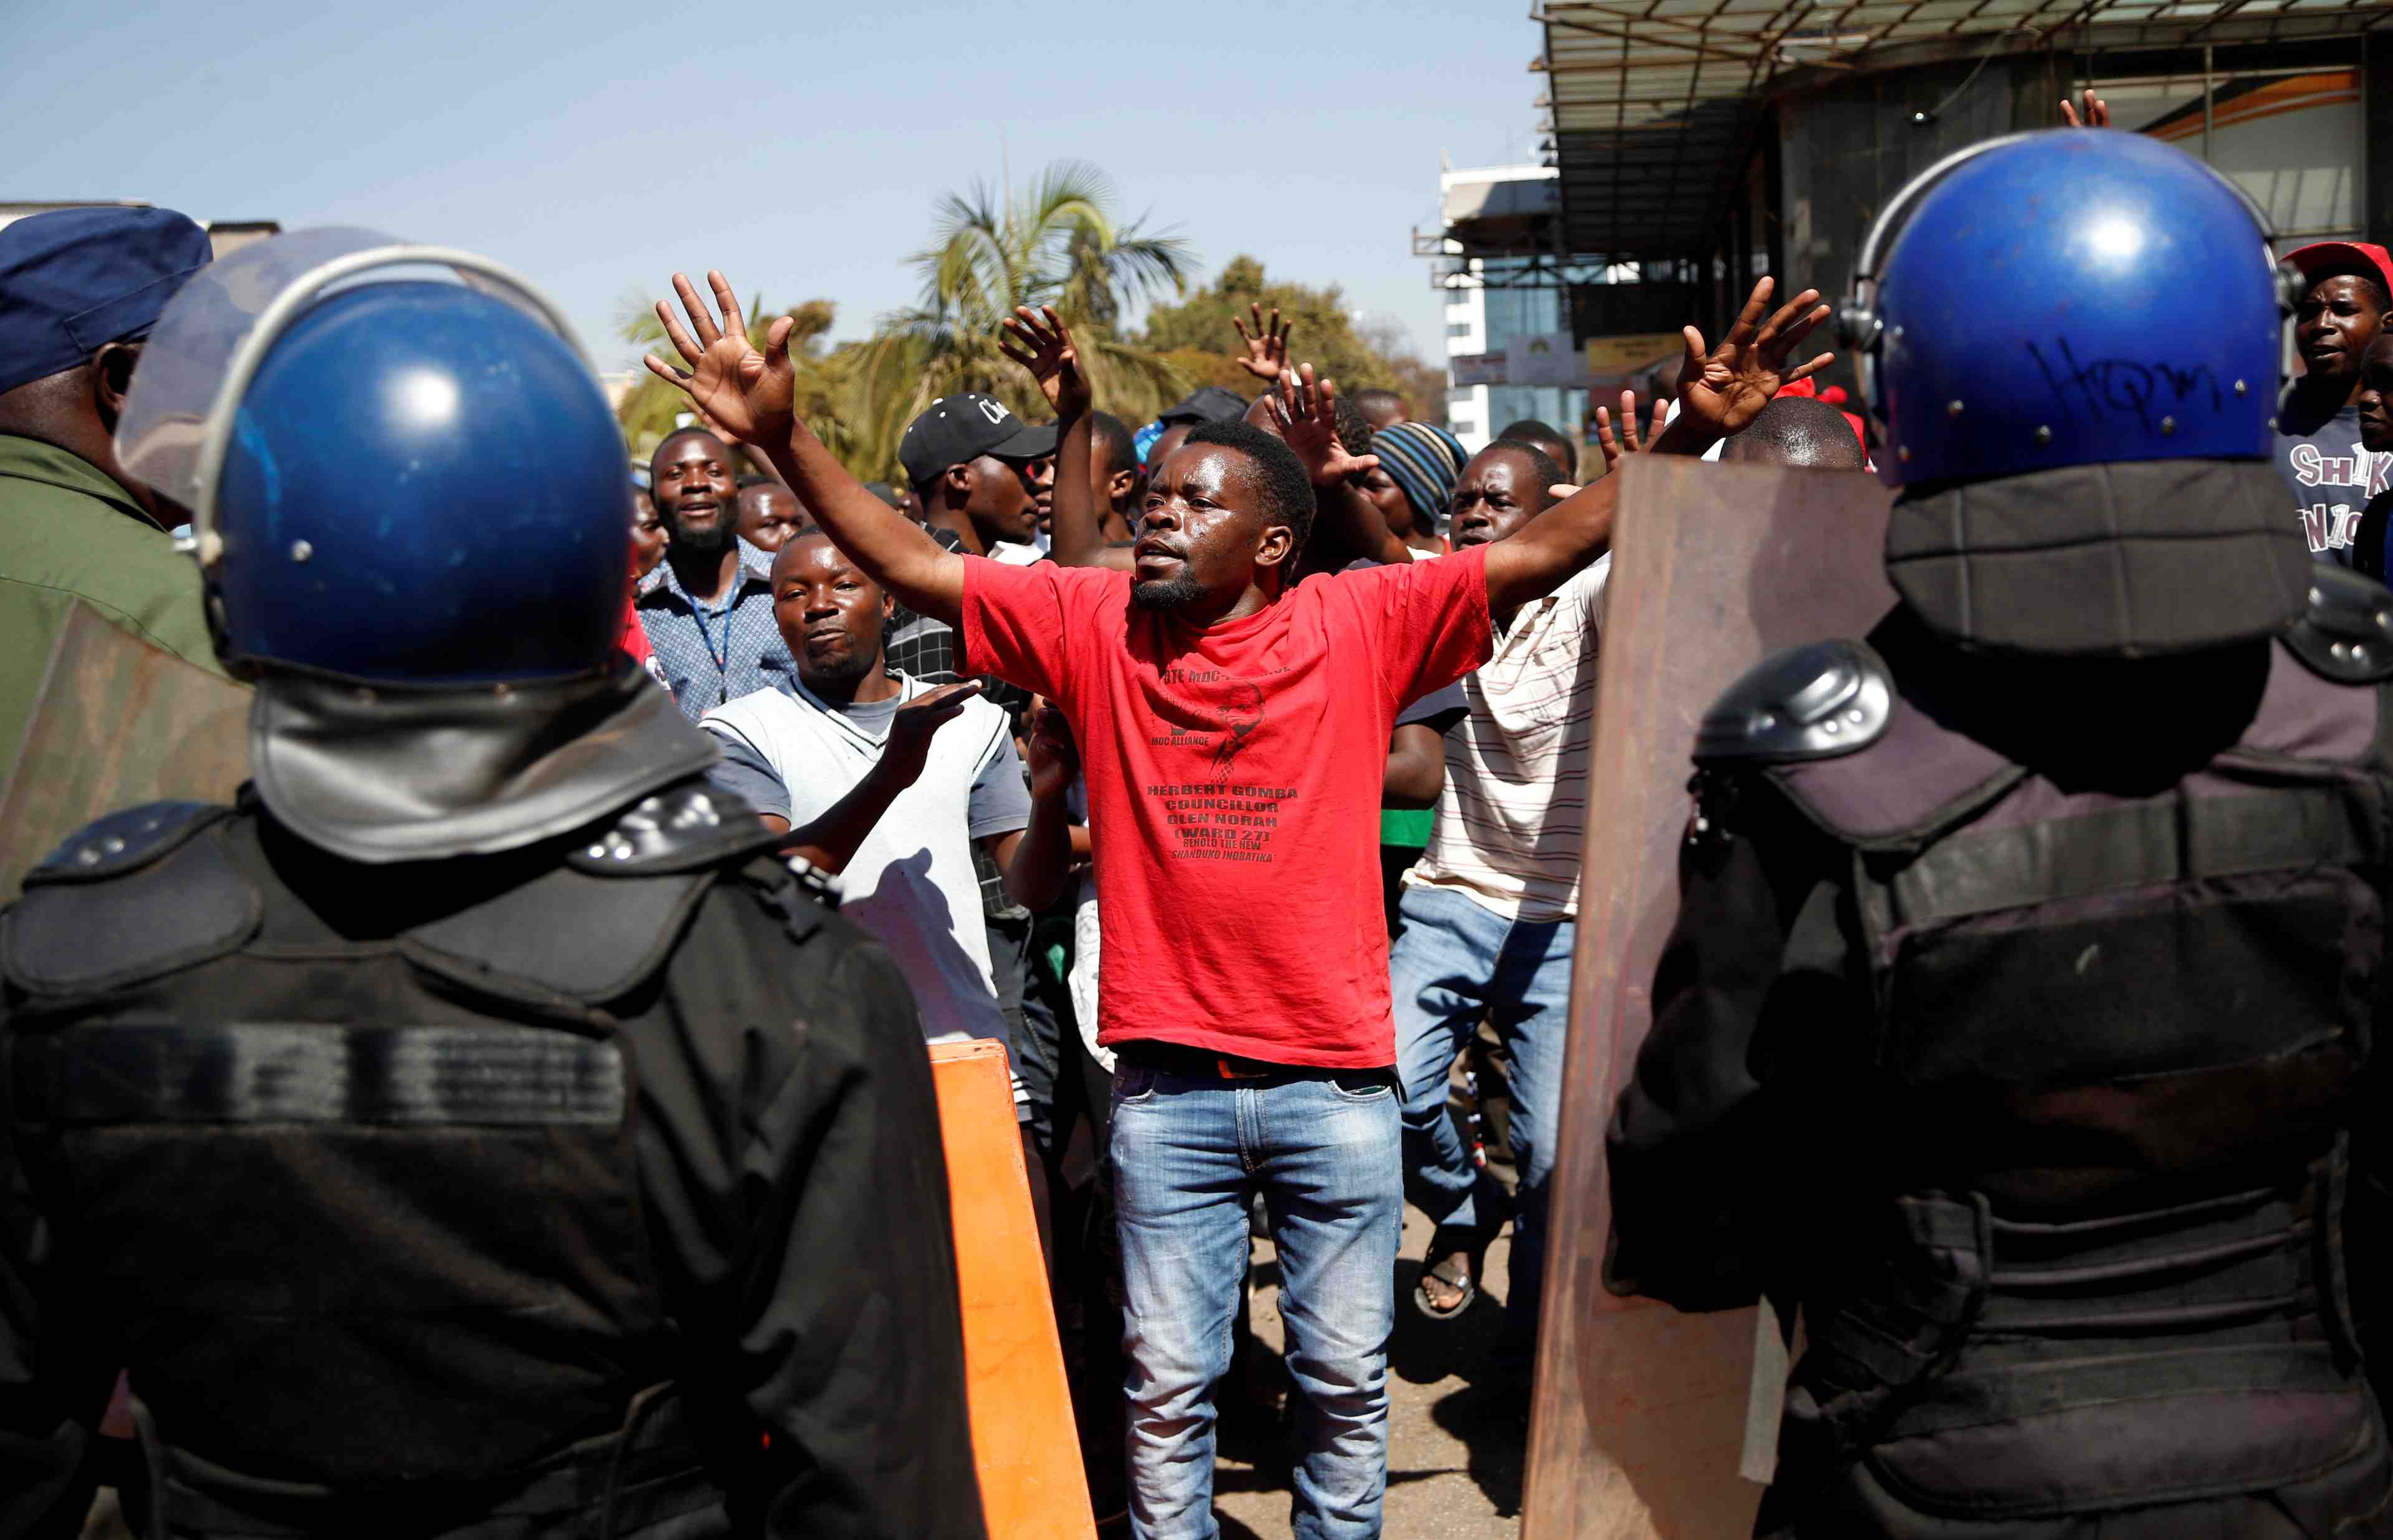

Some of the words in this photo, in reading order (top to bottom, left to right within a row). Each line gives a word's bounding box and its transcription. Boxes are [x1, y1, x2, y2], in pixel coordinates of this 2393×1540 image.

[1151, 737, 1169, 746] MDC
[1171, 736, 1210, 746] ALLIANCE
[1147, 784, 1226, 796] HERBERT
[1232, 786, 1299, 799] GOMBA
[1166, 799, 1279, 812] COUNCILLOR
[1167, 813, 1209, 825] GLEN
[1215, 814, 1278, 827] NORAH
[1175, 827, 1236, 839] (WARD
[1183, 839, 1218, 848] BEHOLD
[1220, 839, 1237, 848] THE
[1239, 840, 1261, 850] NEW
